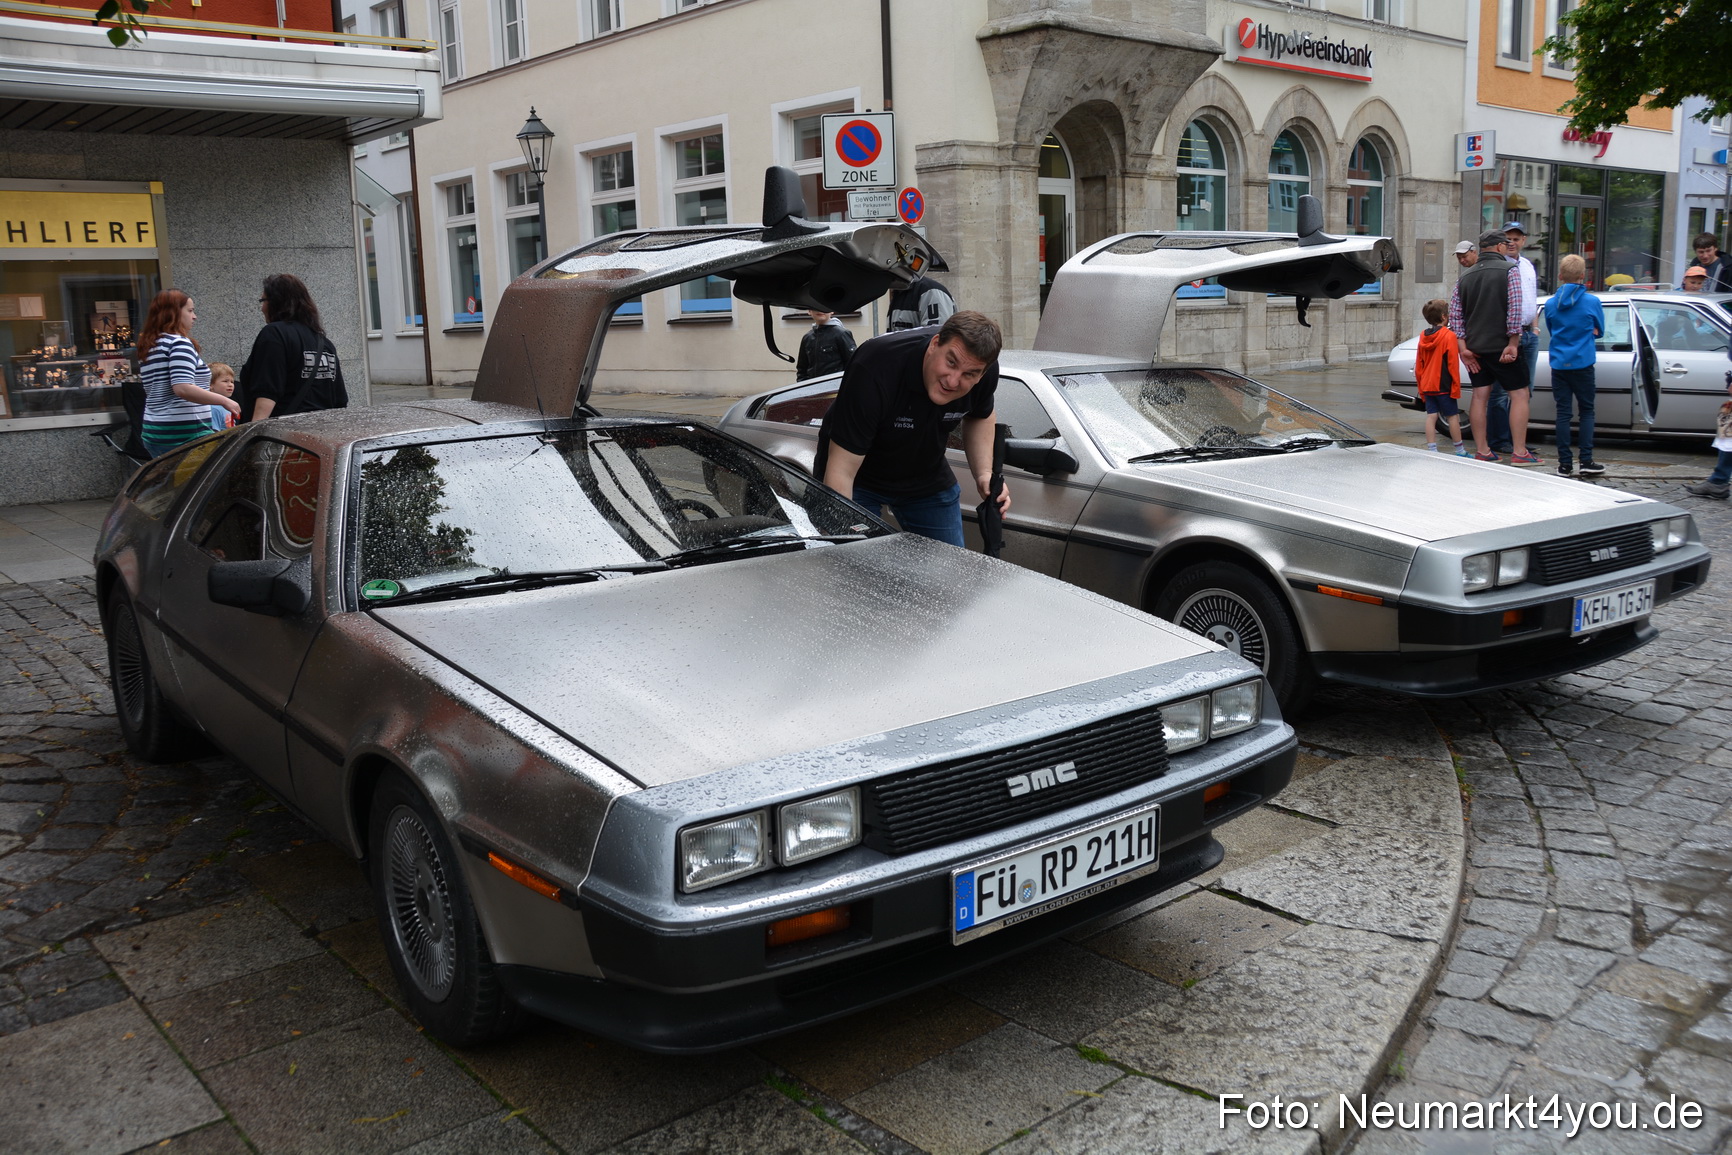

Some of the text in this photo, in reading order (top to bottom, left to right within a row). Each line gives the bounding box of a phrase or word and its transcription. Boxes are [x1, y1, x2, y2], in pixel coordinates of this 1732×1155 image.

[1257, 22, 1373, 69] HypoVereinsbank
[842, 170, 878, 183] ZONE
[855, 195, 891, 203] Bewohner
[1582, 585, 1653, 626] KEH TG 3H
[976, 816, 1153, 917] FÜ RP 211H
[959, 906, 968, 920] D
[1004, 880, 1117, 926] WWW.DELOREANCLUB.DE
